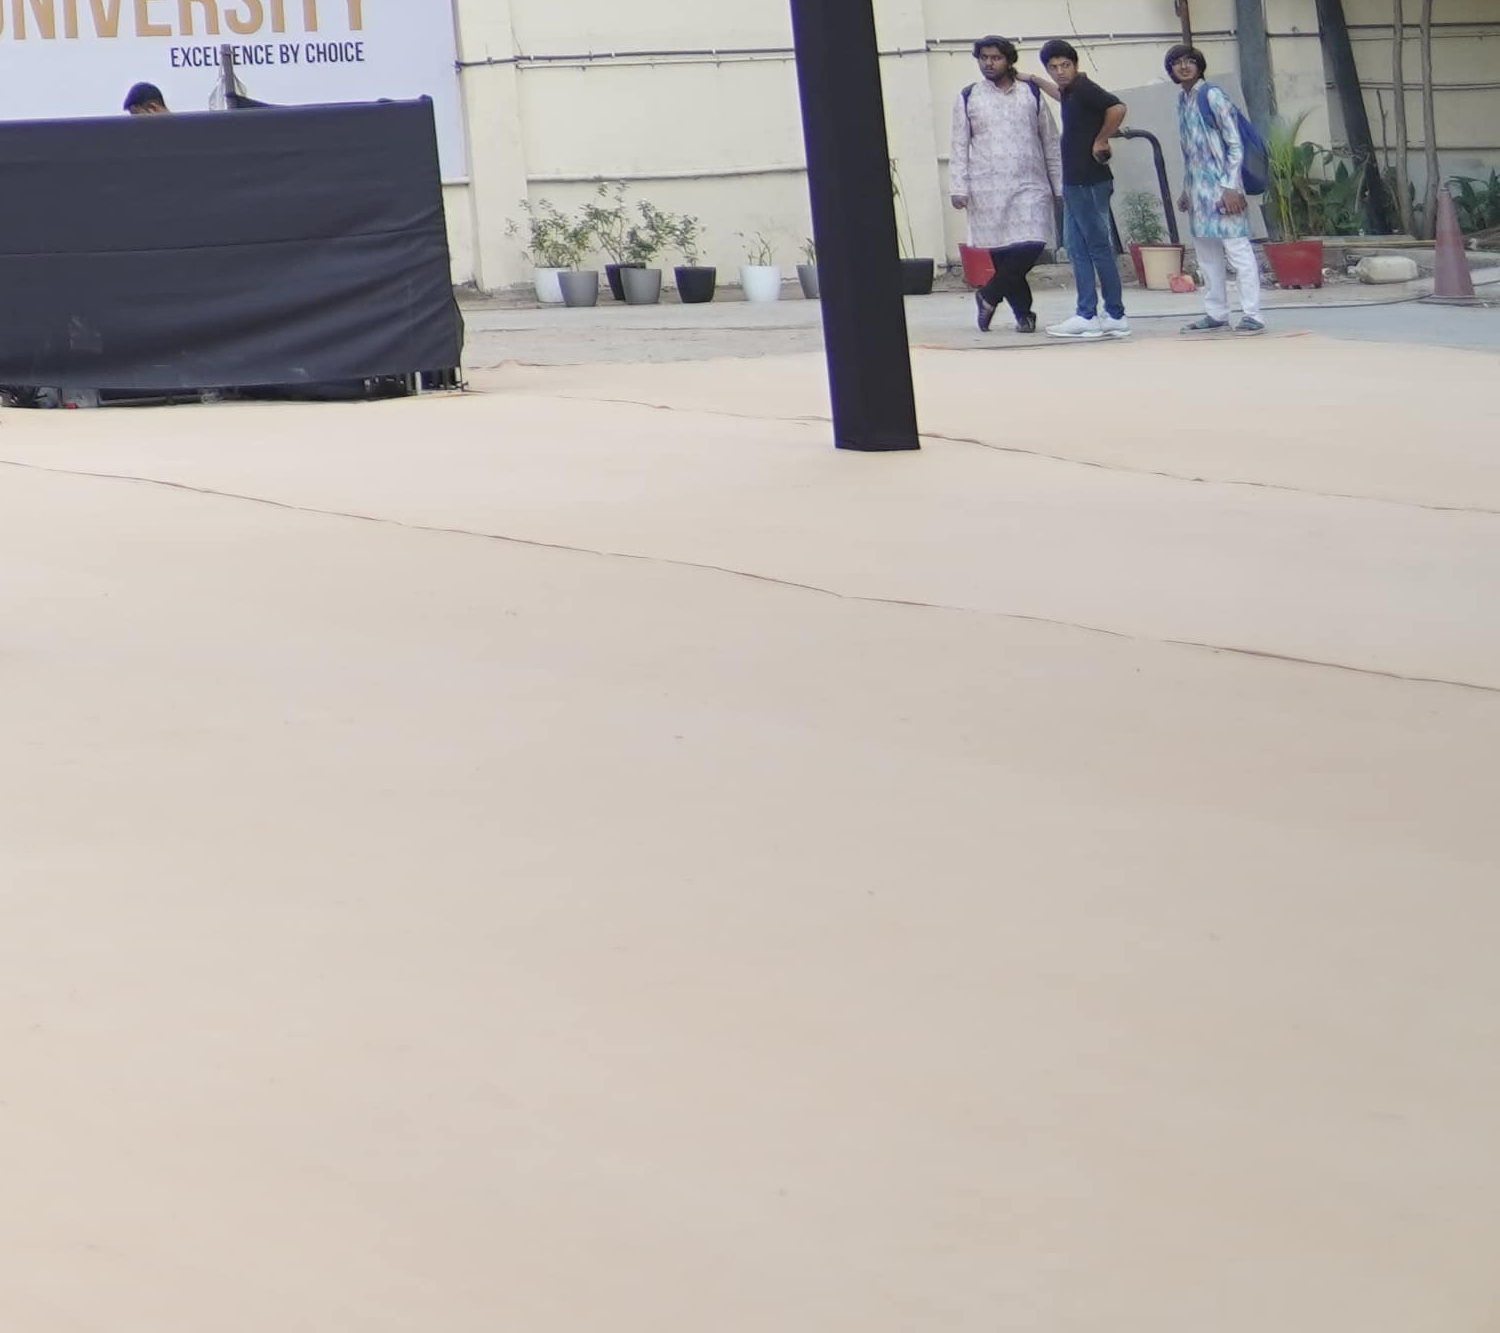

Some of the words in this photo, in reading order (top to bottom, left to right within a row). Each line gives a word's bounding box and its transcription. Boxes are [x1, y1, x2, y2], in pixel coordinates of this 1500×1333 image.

[170, 44, 274, 68] EXCELENCE
[279, 44, 300, 64] BY
[305, 41, 364, 63] CHOICE
